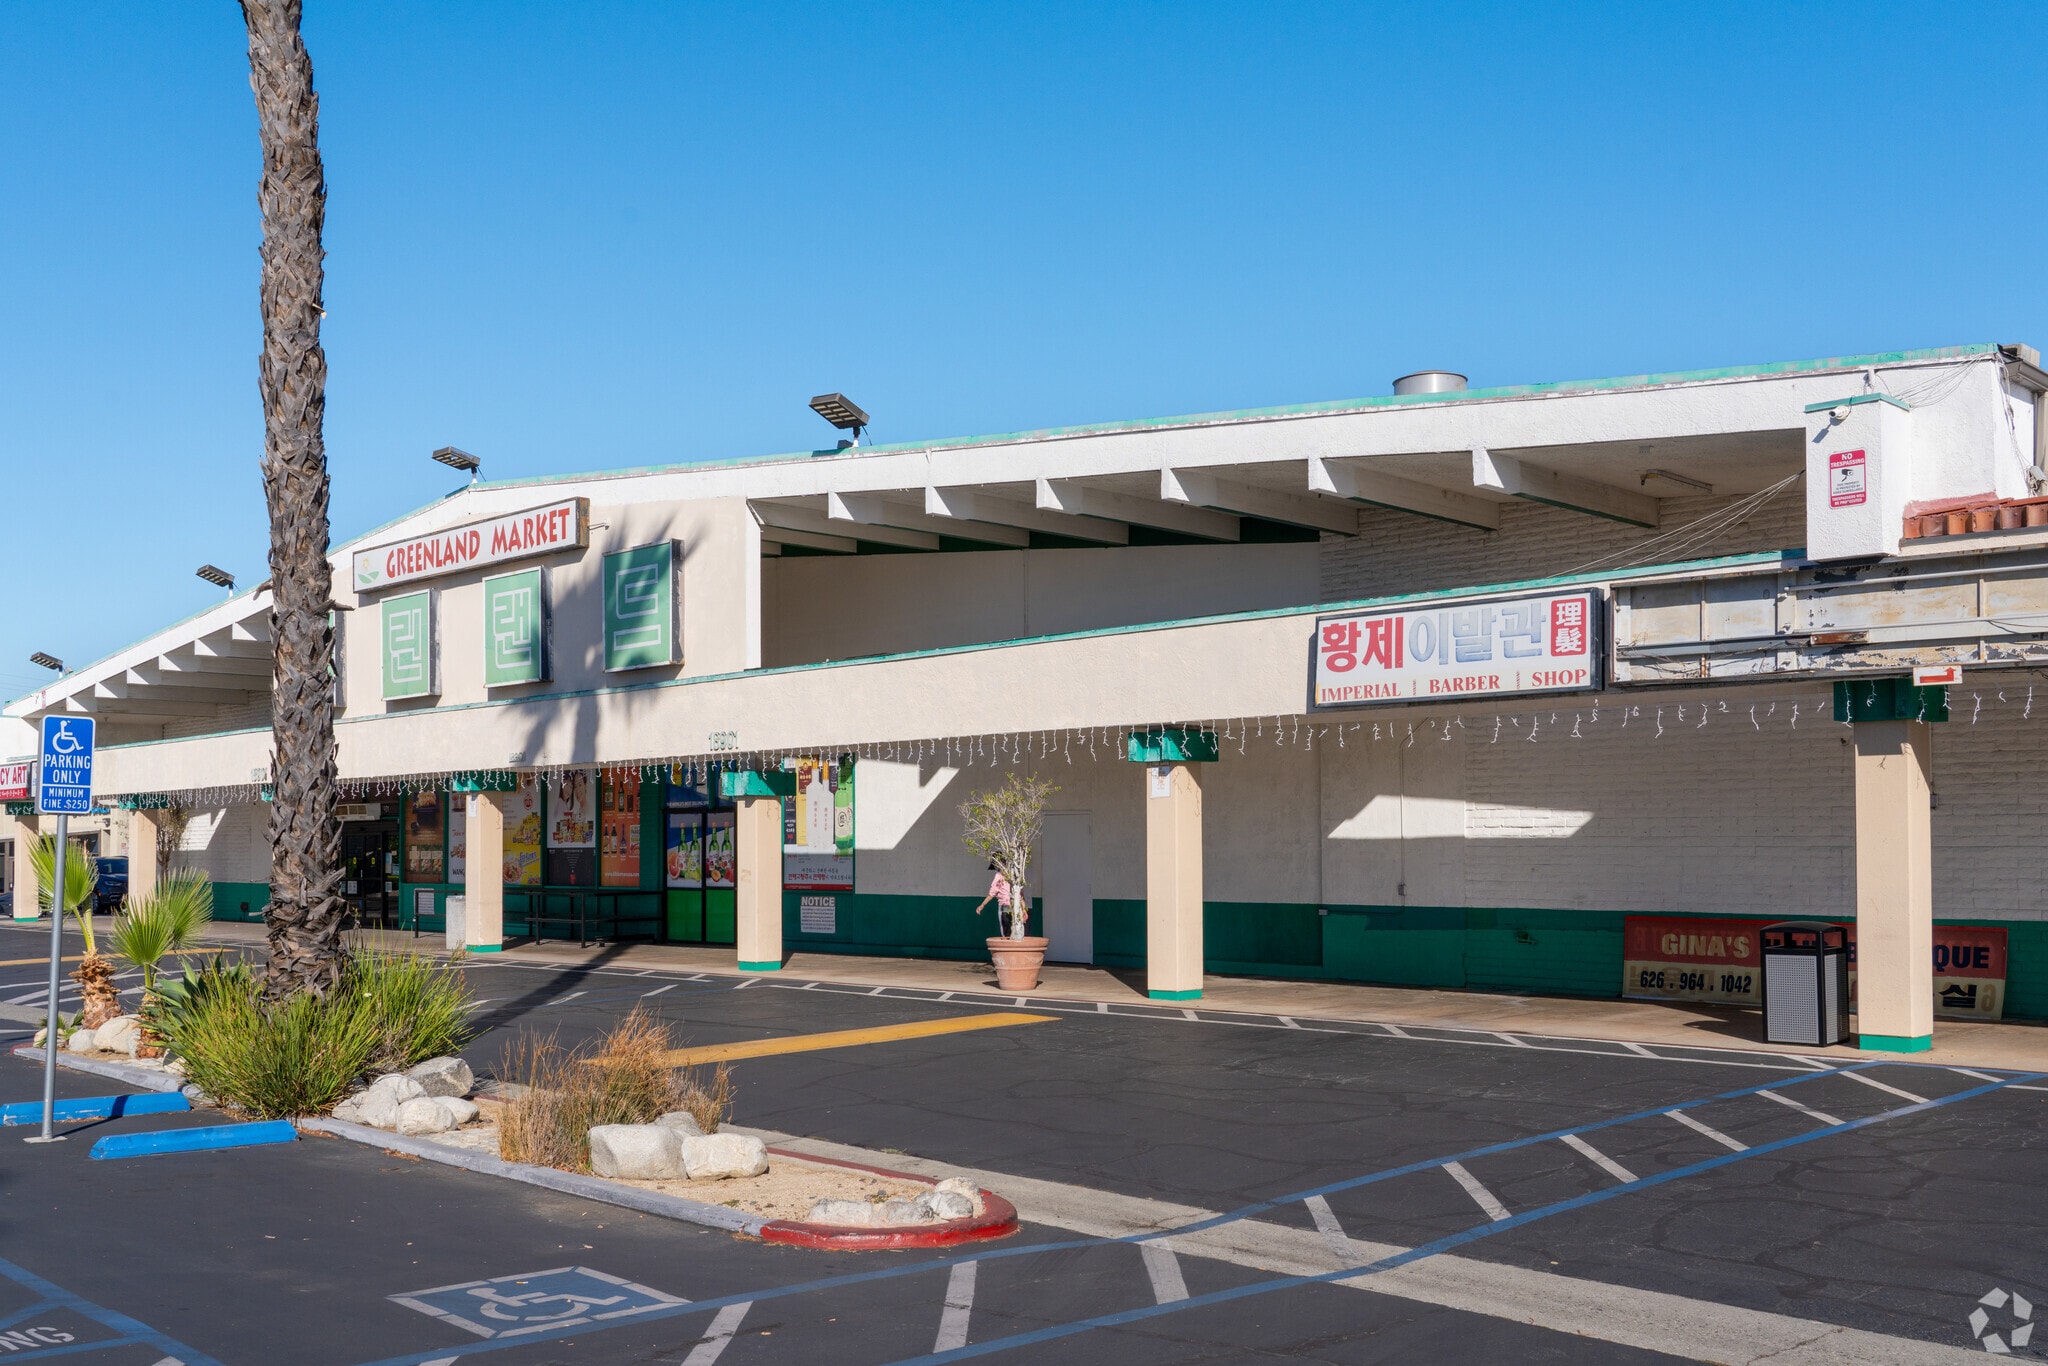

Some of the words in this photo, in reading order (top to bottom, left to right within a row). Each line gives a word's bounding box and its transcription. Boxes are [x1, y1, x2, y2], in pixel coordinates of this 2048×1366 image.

[1831, 458, 1864, 468] TRESPASSING
[386, 530, 481, 579] GREENLAND
[491, 507, 571, 556] MARKET
[1321, 682, 1402, 702] IMPERIAL
[1429, 674, 1501, 693] BARBER
[1531, 669, 1587, 687] SHOP
[44, 754, 91, 769] PARKING
[0, 767, 11, 785] CY
[12, 766, 27, 785] ART
[53, 769, 81, 784] ONLY
[49, 788, 84, 798] MINIMUM
[43, 799, 62, 809] FINE
[64, 799, 88, 809] $250
[801, 896, 836, 907] NOTICE
[1661, 932, 1750, 959] GINA'S
[1720, 974, 1752, 993] 1042
